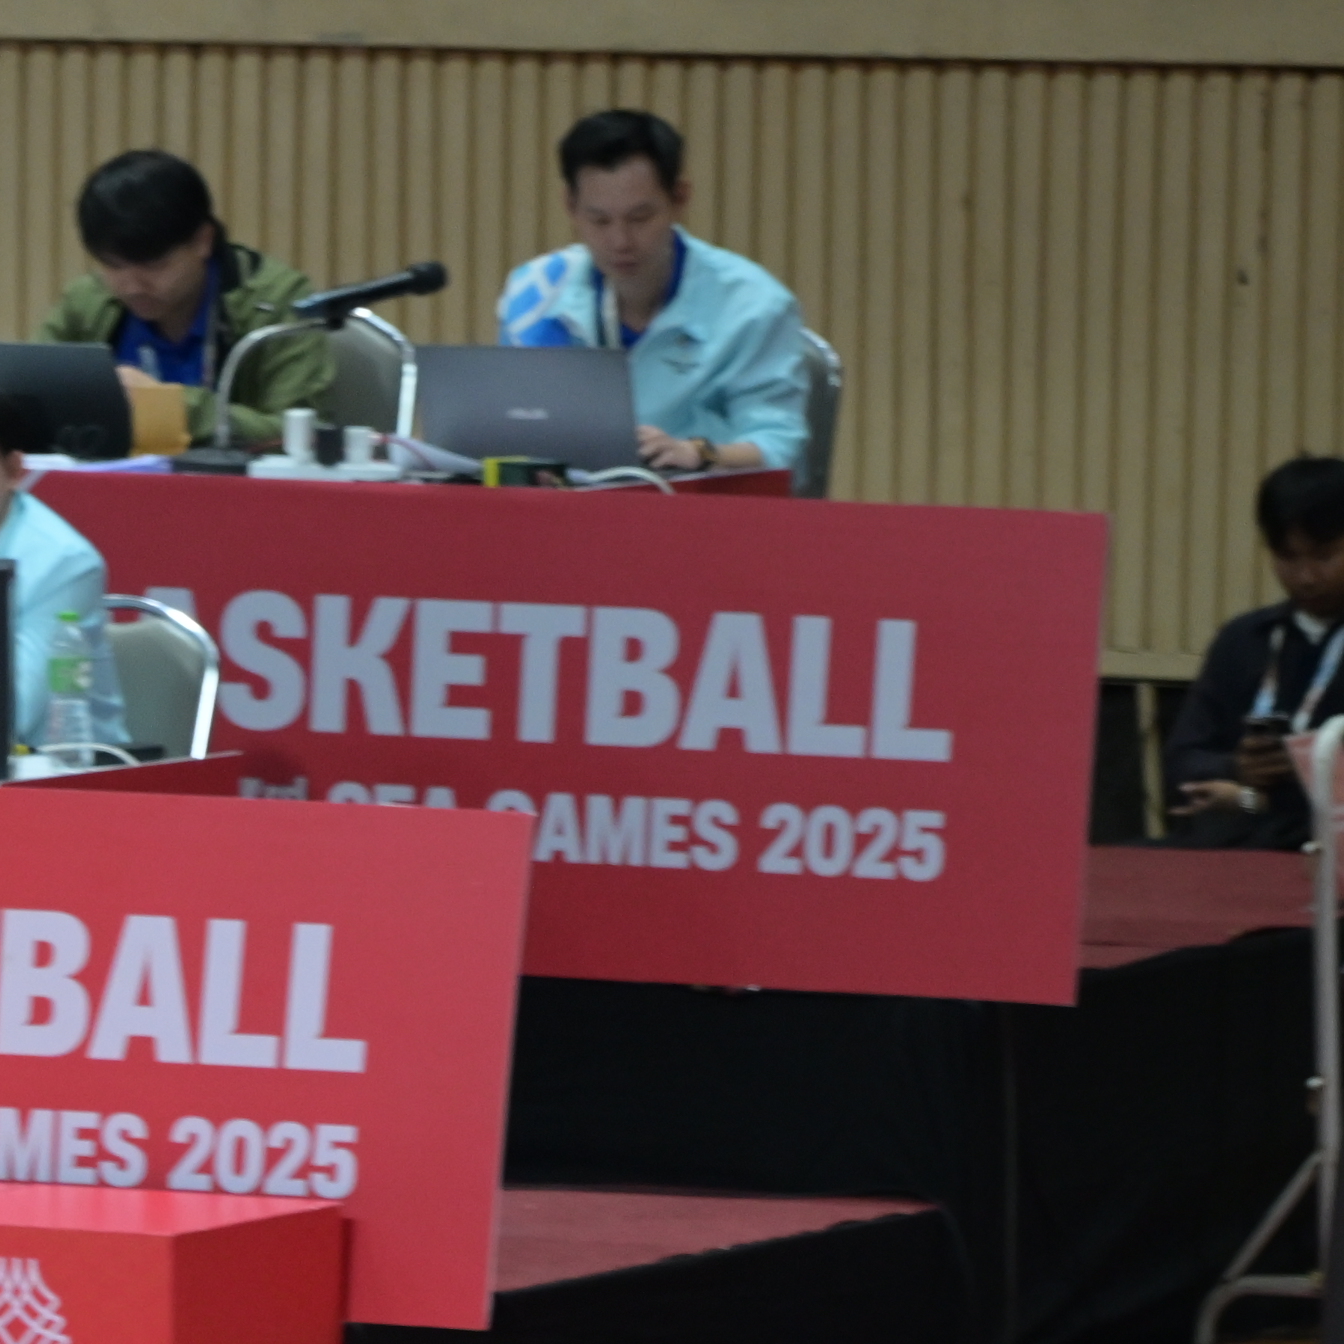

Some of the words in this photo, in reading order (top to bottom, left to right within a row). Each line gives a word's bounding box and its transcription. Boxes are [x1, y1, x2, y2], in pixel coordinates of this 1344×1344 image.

[145, 586, 953, 762] SKETBALL
[757, 802, 946, 882] 2025
[167, 1115, 359, 1199] 2025
